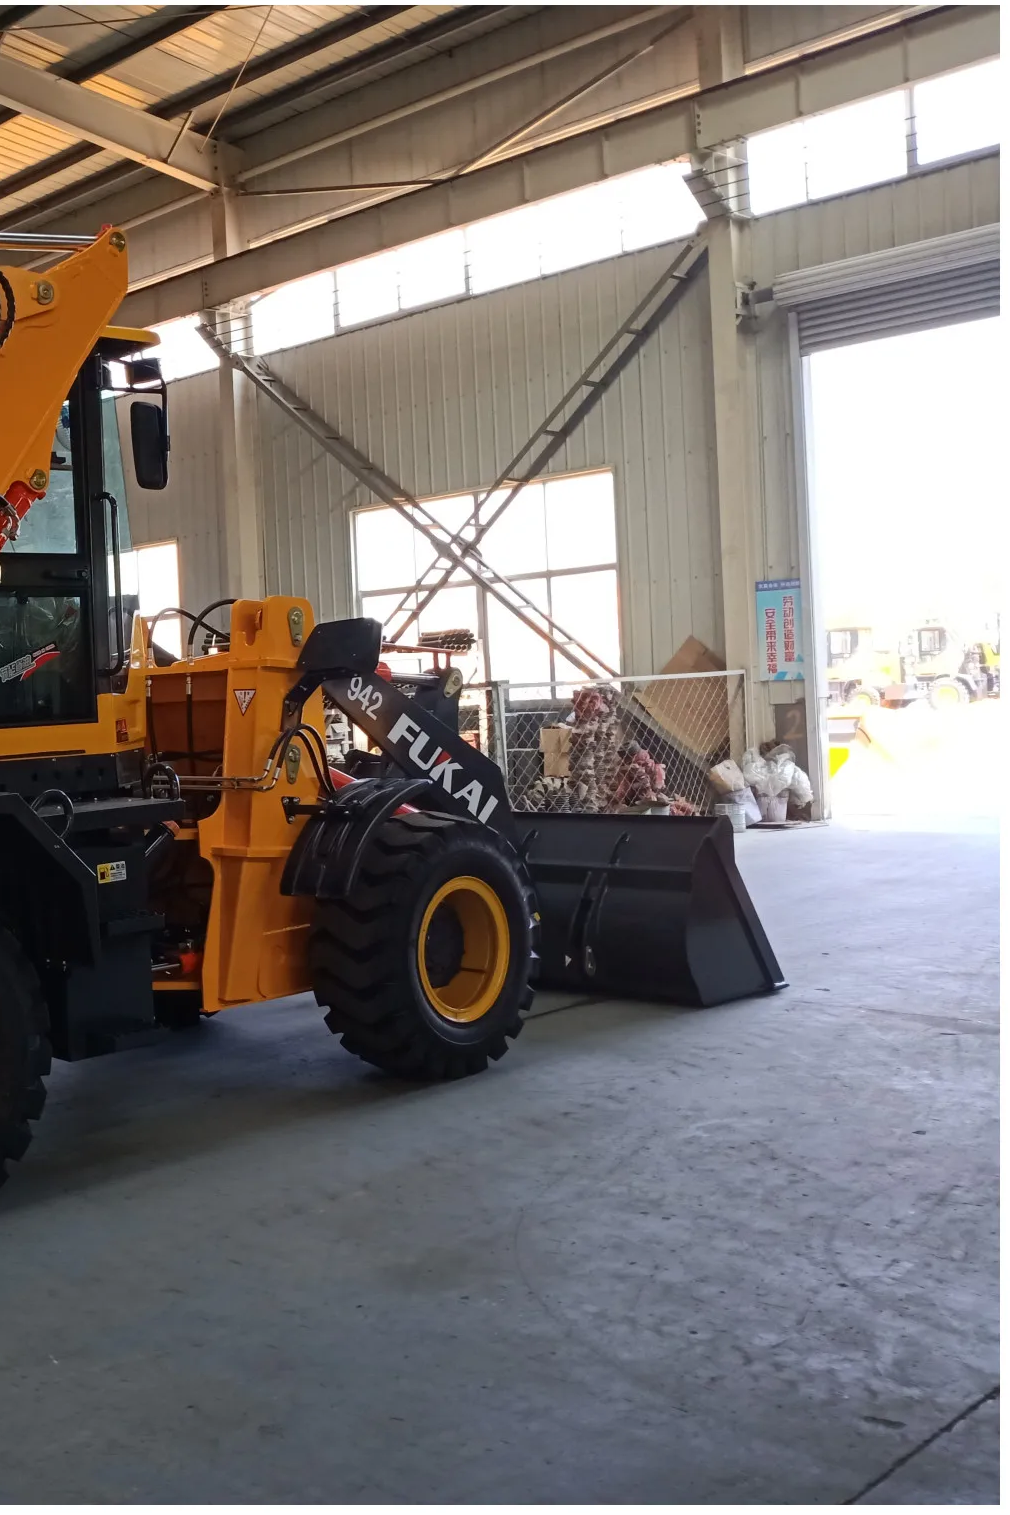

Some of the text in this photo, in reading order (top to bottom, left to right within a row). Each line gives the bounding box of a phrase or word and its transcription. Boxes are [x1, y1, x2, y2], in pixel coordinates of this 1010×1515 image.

[765, 608, 778, 674] 安全带来幸福
[782, 595, 795, 662] 劳动创造财富
[347, 676, 498, 825] 942 FUKAI
[783, 709, 803, 740] 2
